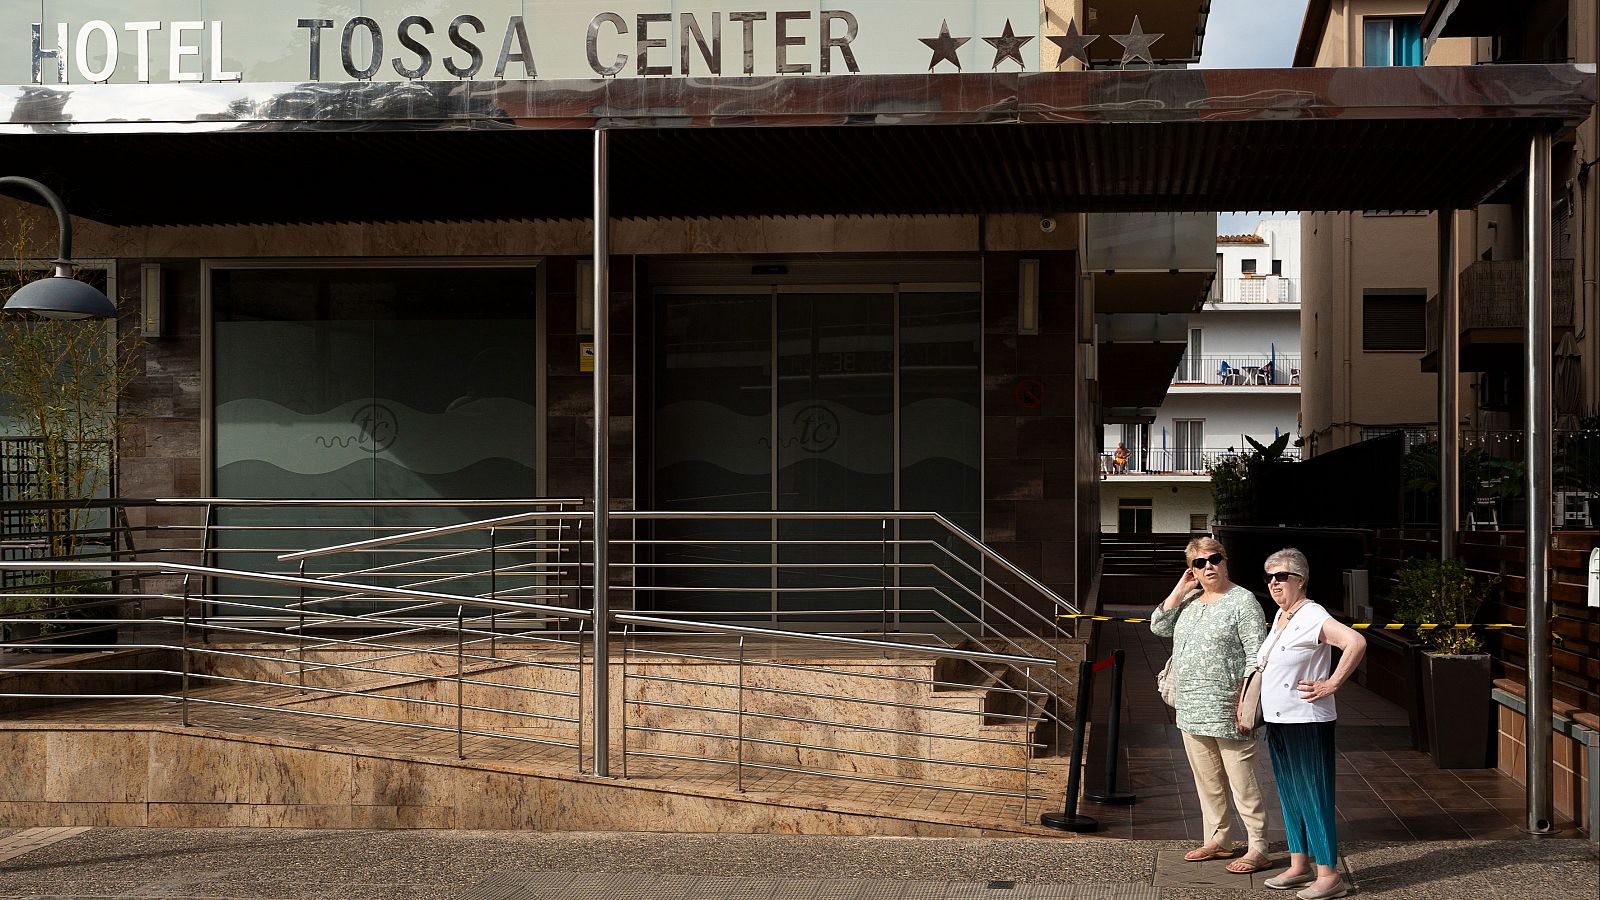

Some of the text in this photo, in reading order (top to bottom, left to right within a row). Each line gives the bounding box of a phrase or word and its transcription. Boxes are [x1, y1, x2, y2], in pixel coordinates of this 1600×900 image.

[31, 10, 860, 84] HOTEL TOSSA CENTER
